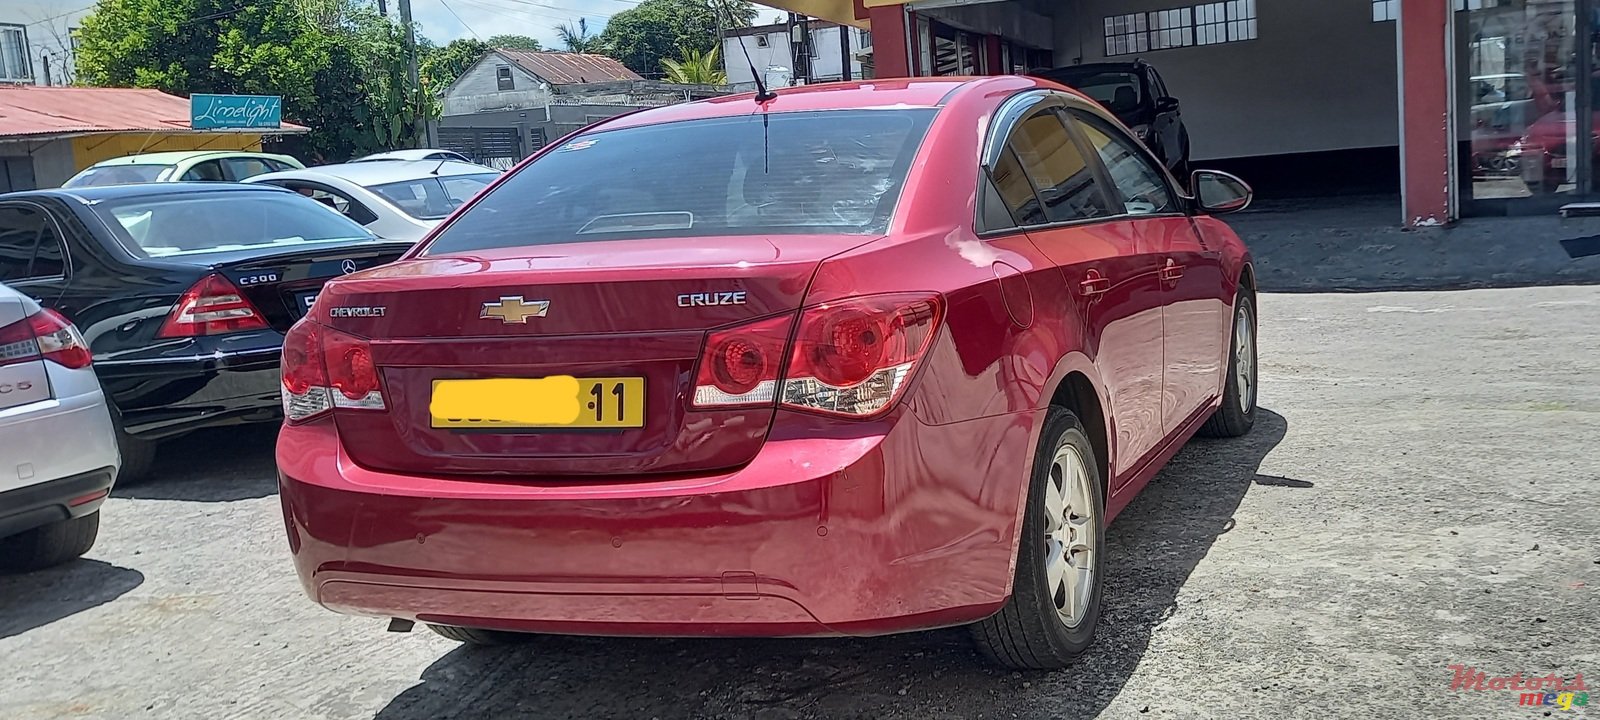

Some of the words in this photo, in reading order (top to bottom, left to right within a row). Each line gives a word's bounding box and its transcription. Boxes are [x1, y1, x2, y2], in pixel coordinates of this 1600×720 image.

[194, 97, 279, 127] Limelight
[677, 291, 746, 307] CRUZE
[330, 307, 386, 317] CHEVROLET
[0, 381, 32, 393] C5
